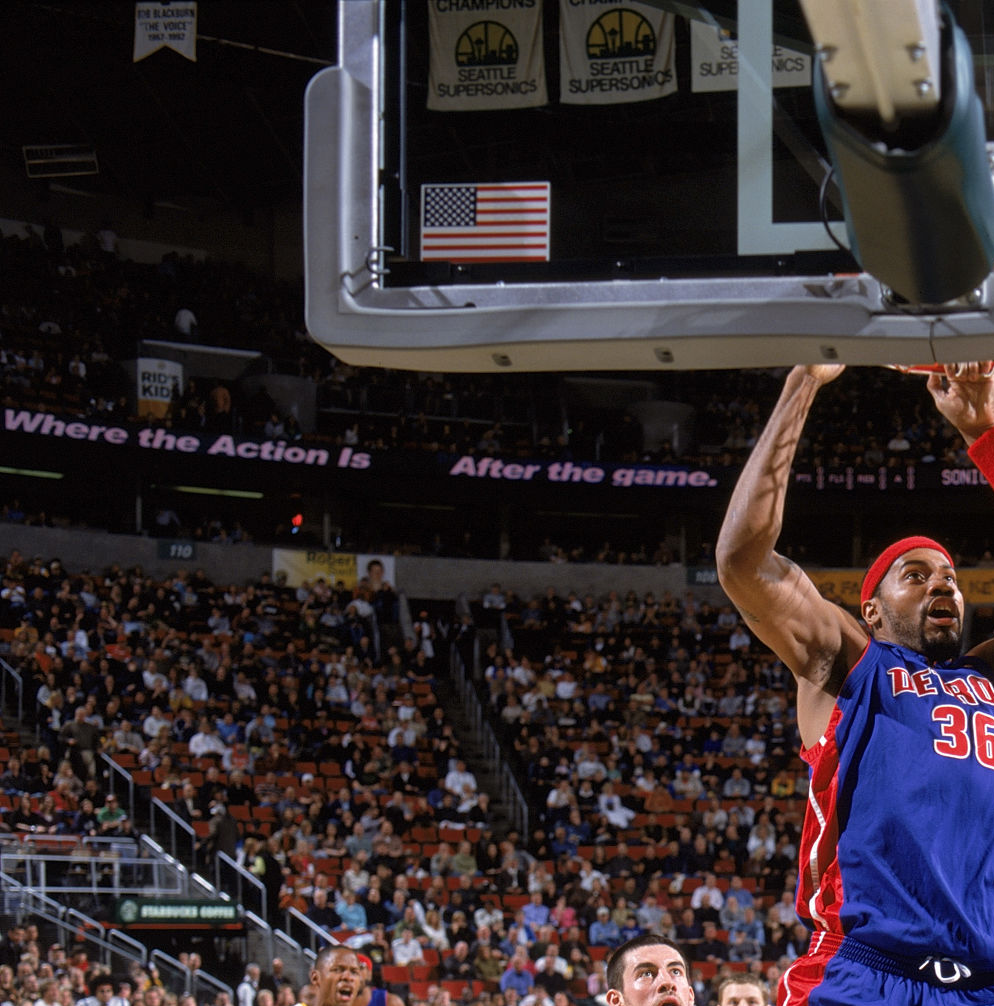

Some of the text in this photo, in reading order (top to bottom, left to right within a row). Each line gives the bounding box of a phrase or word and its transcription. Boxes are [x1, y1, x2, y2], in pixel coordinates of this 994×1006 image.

[457, 67, 517, 83] SEATTLE
[589, 59, 655, 77] SEATTLE
[437, 79, 537, 98] SUPERSONICS
[568, 69, 673, 94] SUPERSONICS
[4, 408, 372, 470] Where the Action Is
[450, 455, 718, 488] After the game.
[170, 544, 193, 559] 110
